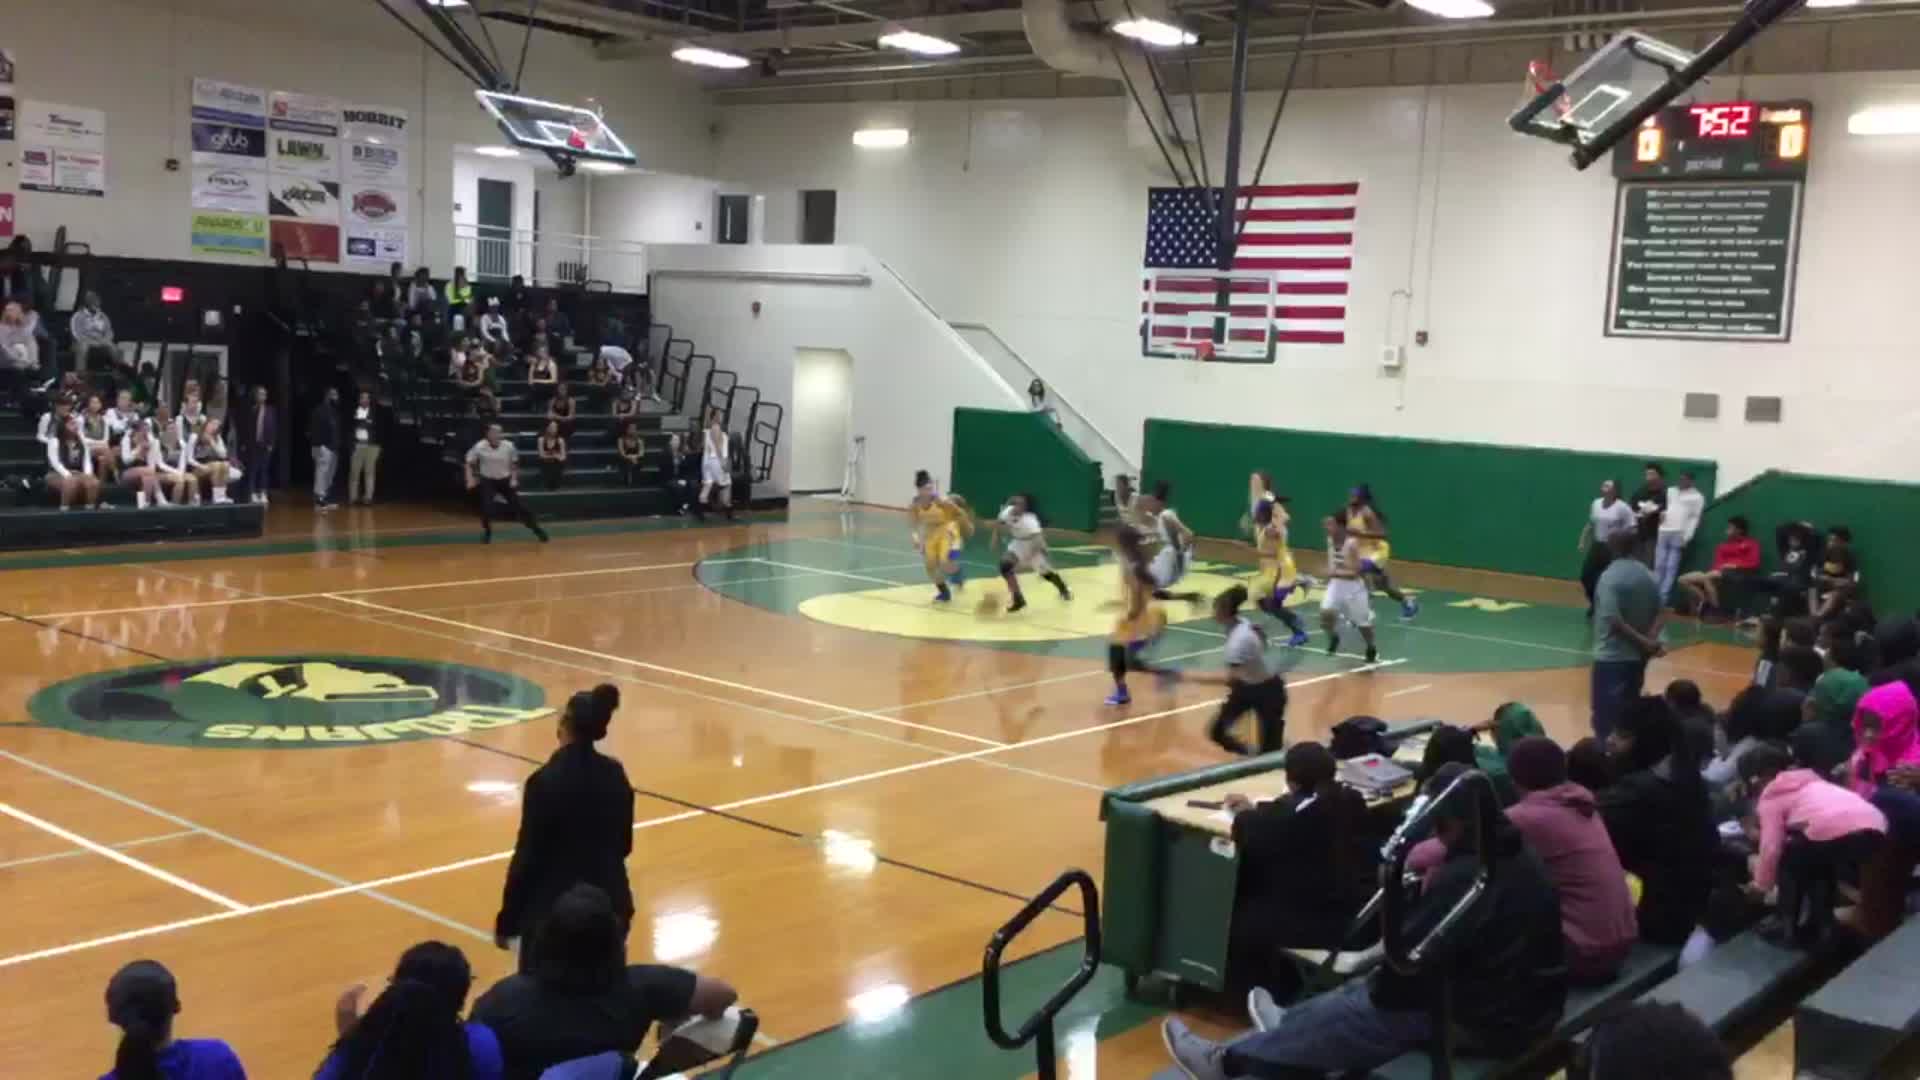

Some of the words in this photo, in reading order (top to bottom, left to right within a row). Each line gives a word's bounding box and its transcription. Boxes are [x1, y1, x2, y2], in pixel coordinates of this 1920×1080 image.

[1690, 106, 1751, 137] 7:52
[1637, 130, 1663, 162] 0
[1779, 124, 1805, 158] 0
